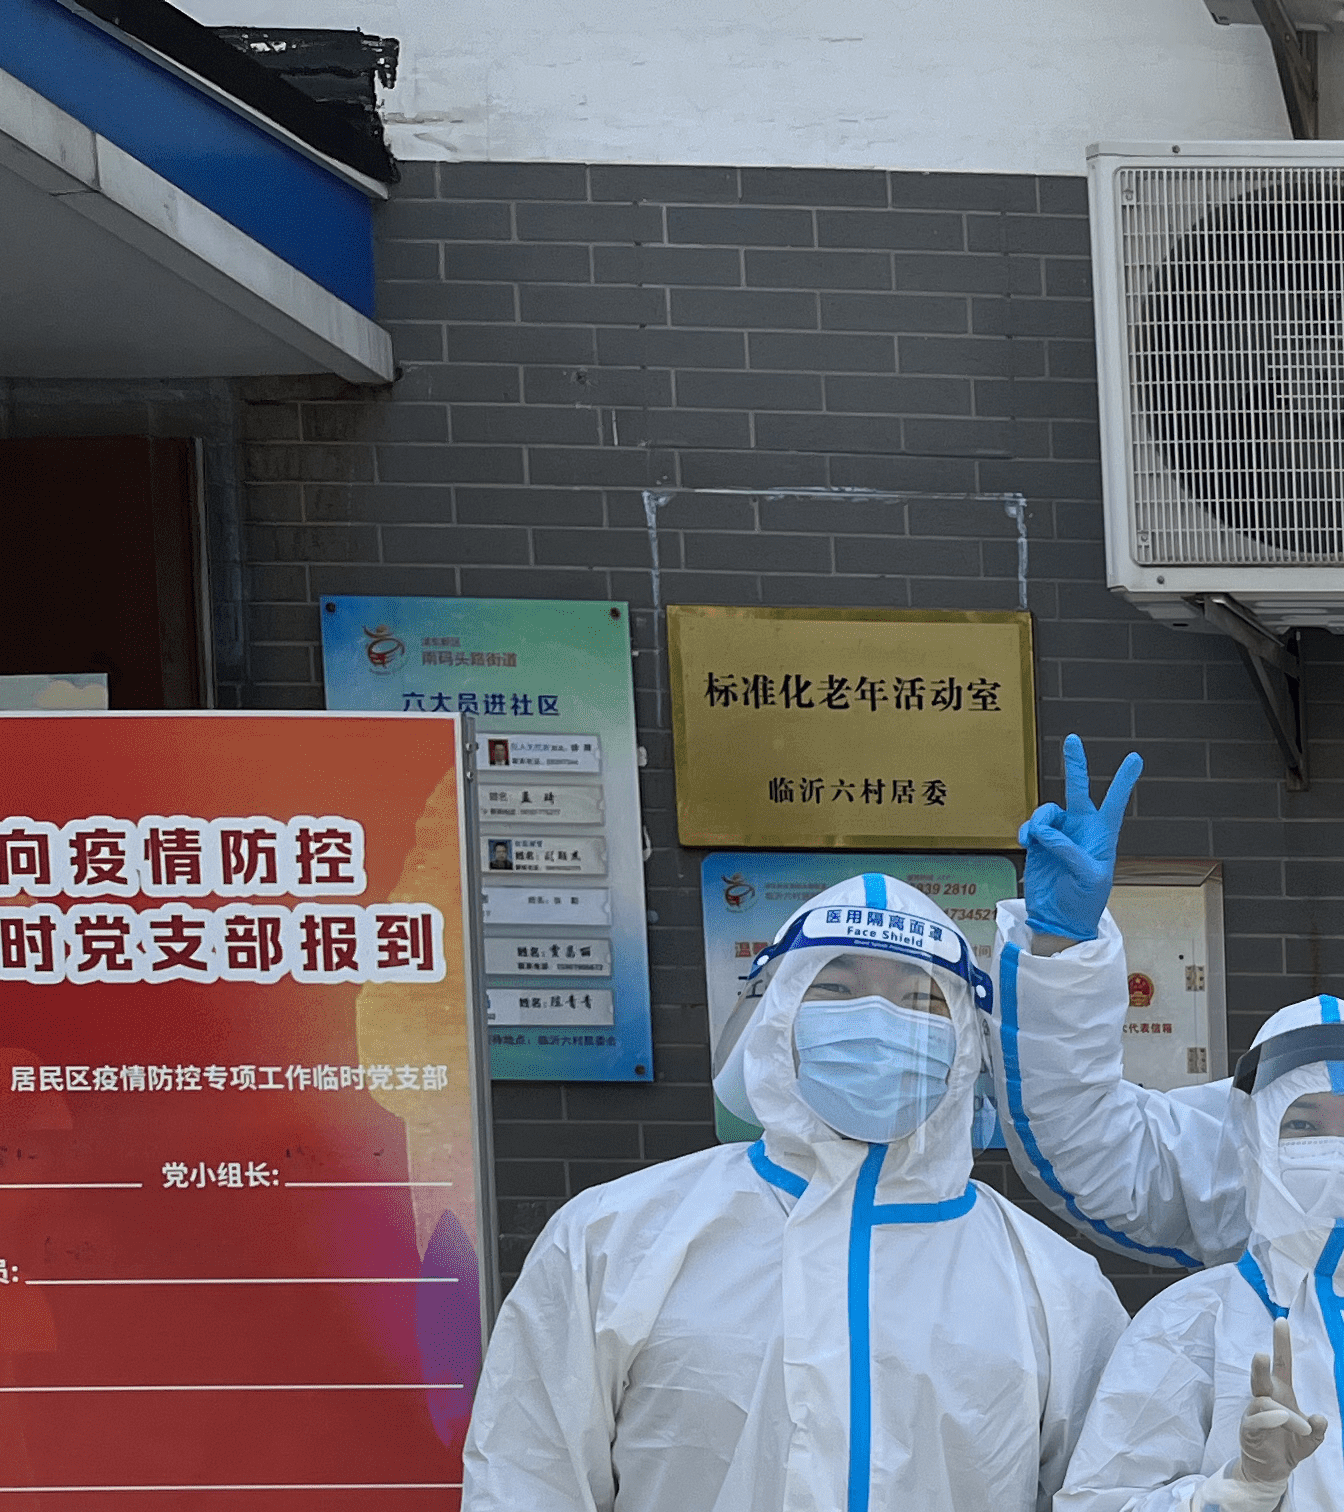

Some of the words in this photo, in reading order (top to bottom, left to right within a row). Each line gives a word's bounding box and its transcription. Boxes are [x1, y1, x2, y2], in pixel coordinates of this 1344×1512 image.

[421, 650, 518, 668] 南码头路街道
[402, 691, 561, 717] 六大员进社区
[703, 672, 1002, 715] 标准化老年活动室
[768, 776, 949, 807] 临沂六村居委
[0, 827, 354, 885] 向疫情防控
[943, 883, 977, 896] 2810
[825, 909, 943, 943] 医用隔离面罩
[846, 925, 878, 940] Face
[882, 930, 923, 948] Shield
[0, 913, 435, 973] 时党支部报到
[10, 1064, 449, 1092] 居民区疫情防控专项工作临时党支部
